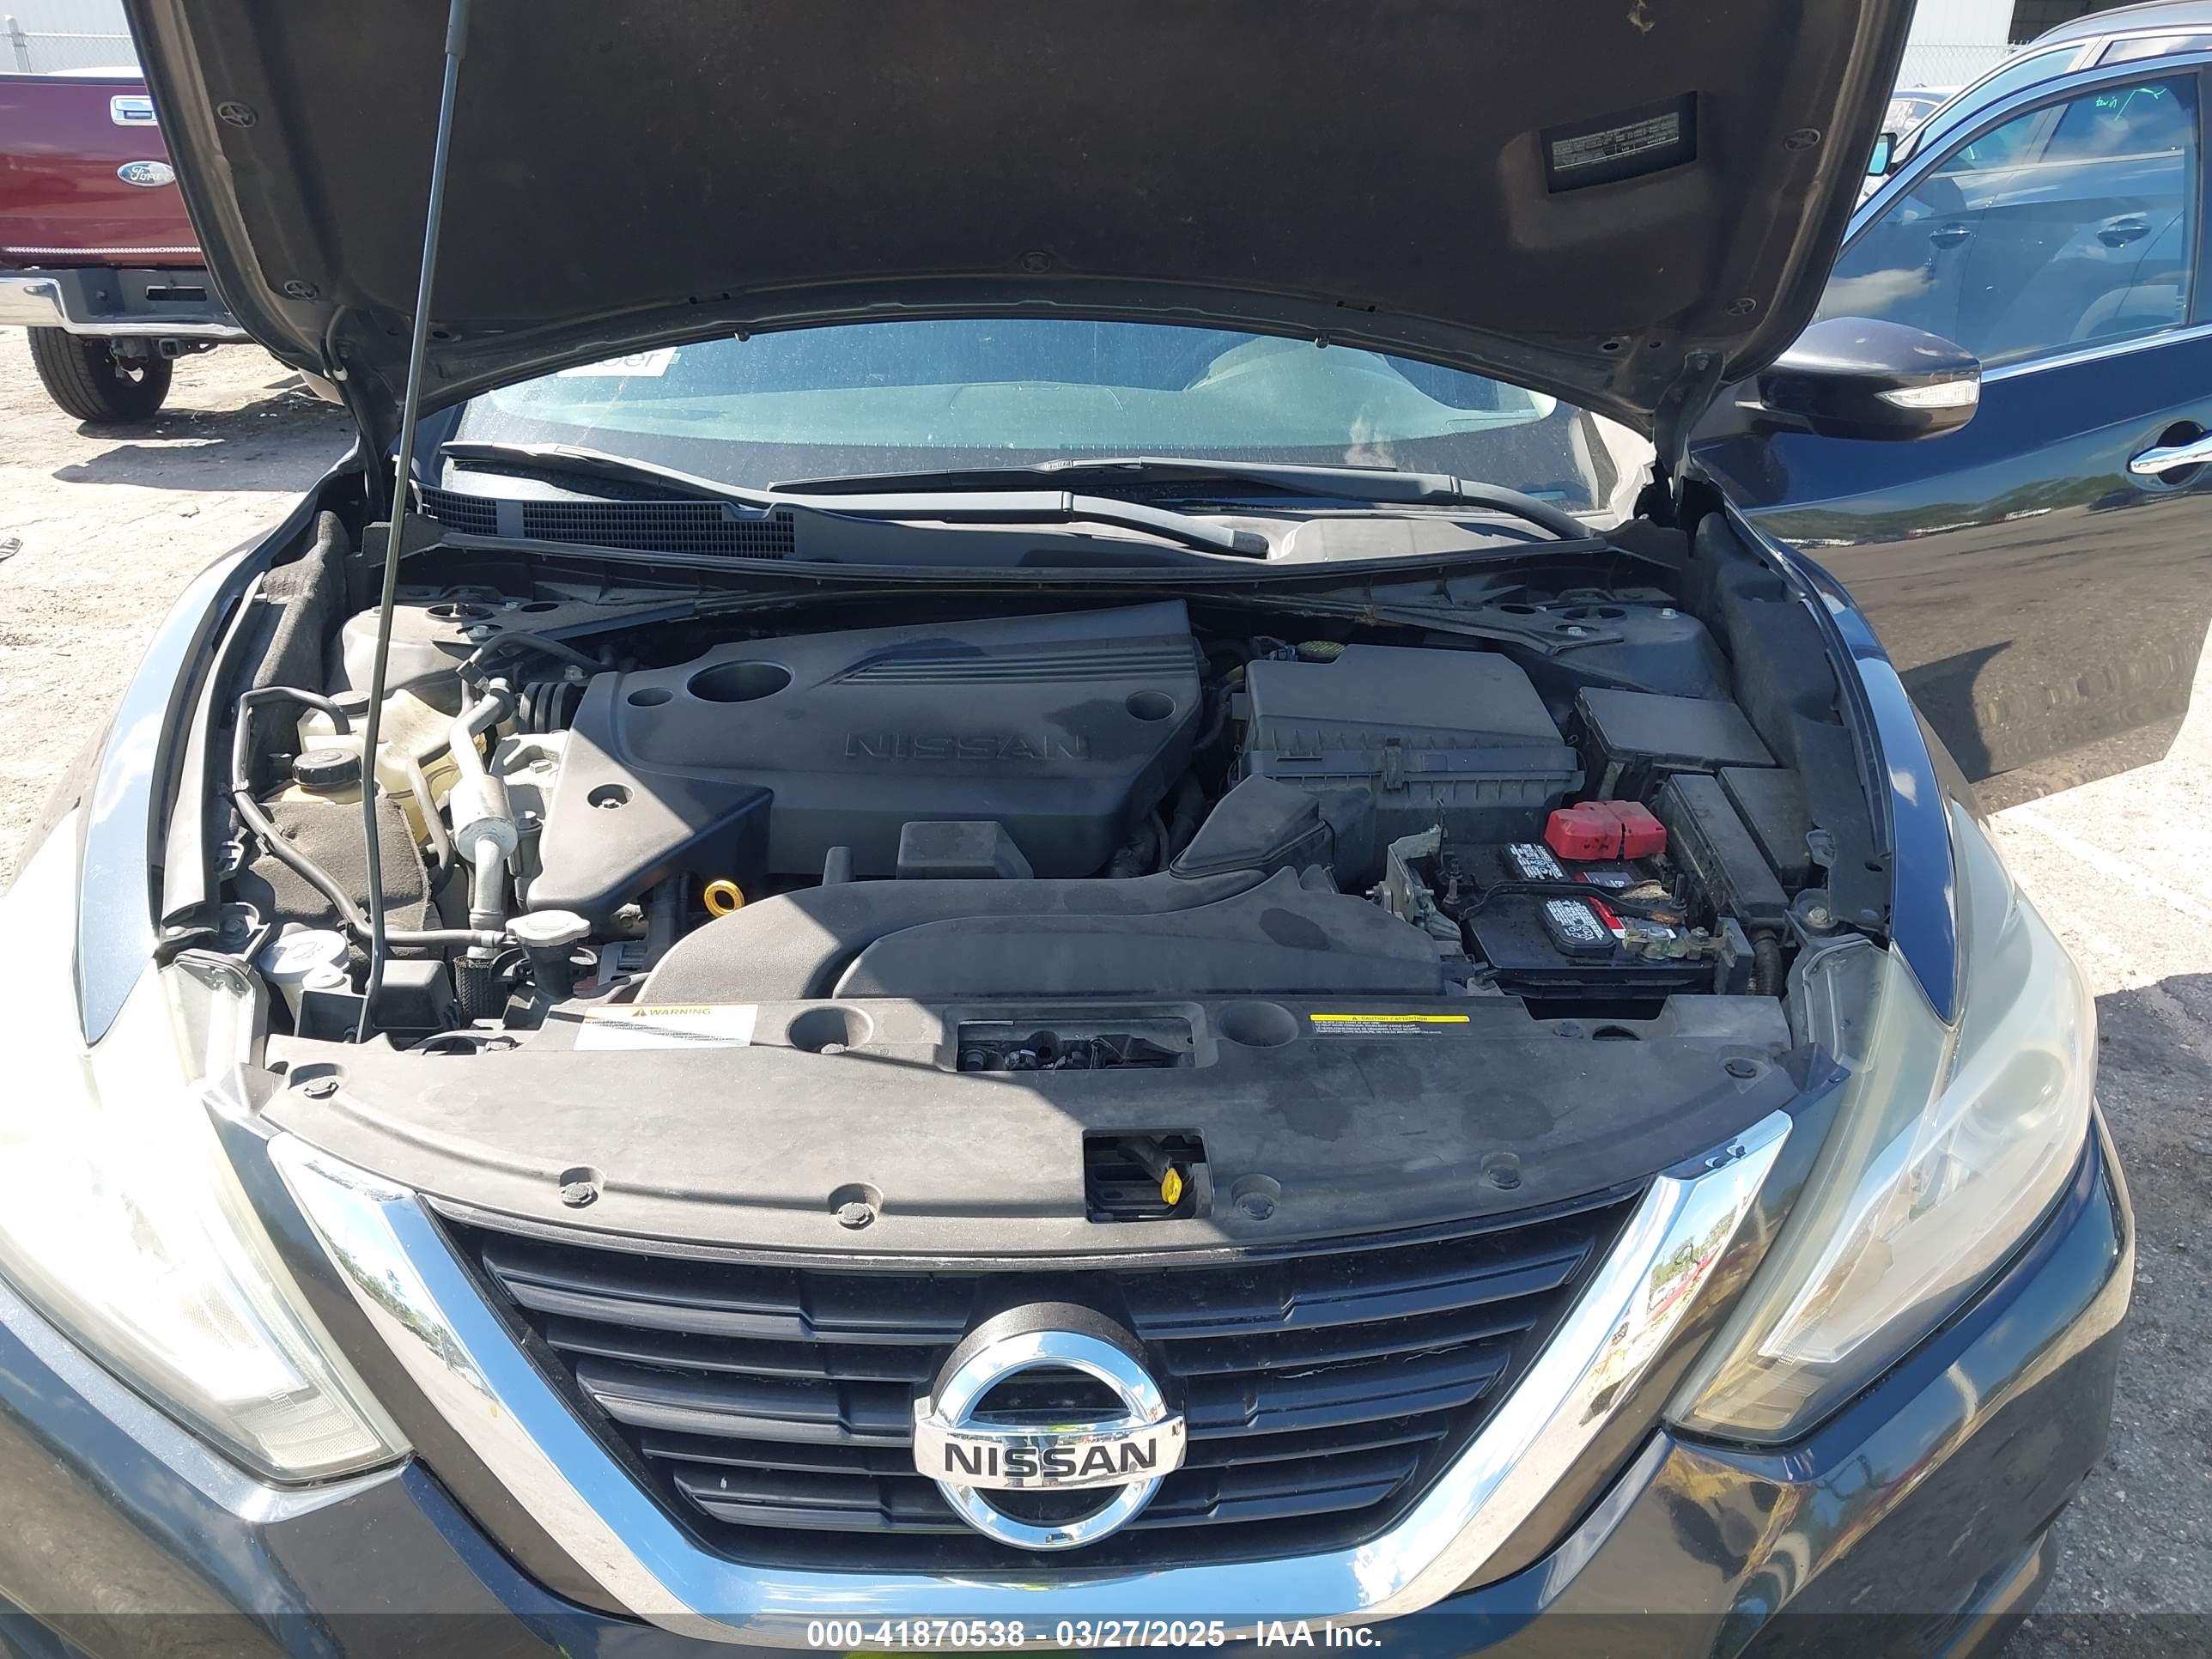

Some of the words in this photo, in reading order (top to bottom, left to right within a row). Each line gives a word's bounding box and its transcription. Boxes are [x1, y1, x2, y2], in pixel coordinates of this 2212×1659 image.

[844, 732, 1091, 760] NISSAN
[649, 1007, 712, 1016] WARNING
[944, 1437, 1157, 1478] NISSAN
